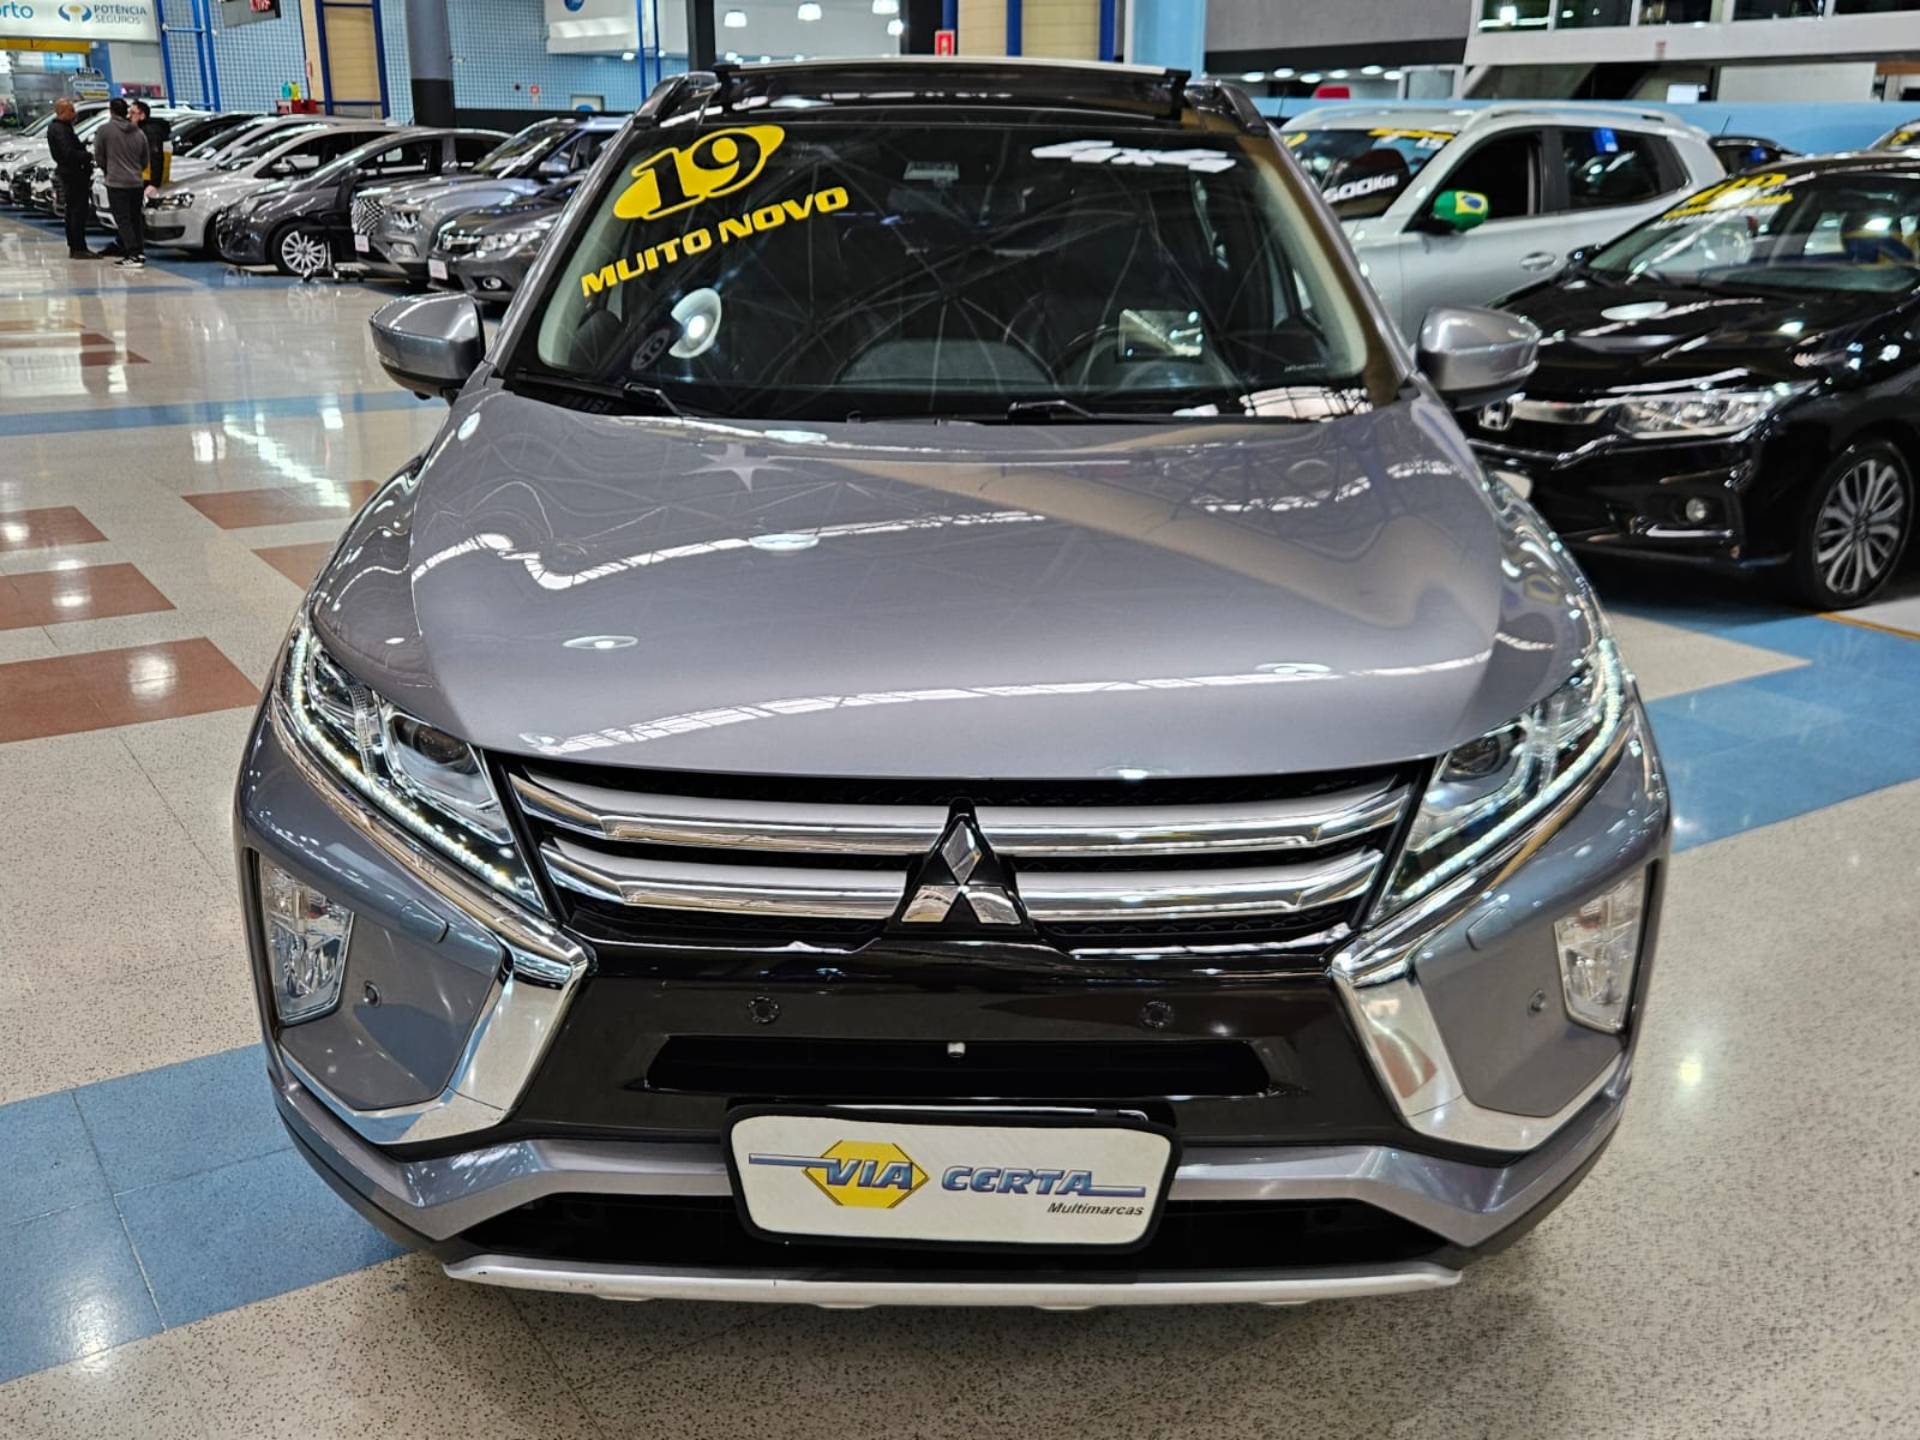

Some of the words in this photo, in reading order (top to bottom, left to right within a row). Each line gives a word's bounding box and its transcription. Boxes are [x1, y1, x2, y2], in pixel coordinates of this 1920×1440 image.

[0, 1, 34, 19] rto
[95, 15, 141, 24] SEGUROS
[632, 129, 762, 216] 19
[580, 228, 713, 298] MUITO
[718, 186, 850, 244] NOVO
[826, 1158, 914, 1190] VIA
[941, 1165, 1093, 1195] CERTA
[1047, 1202, 1145, 1216] Multimarcas
